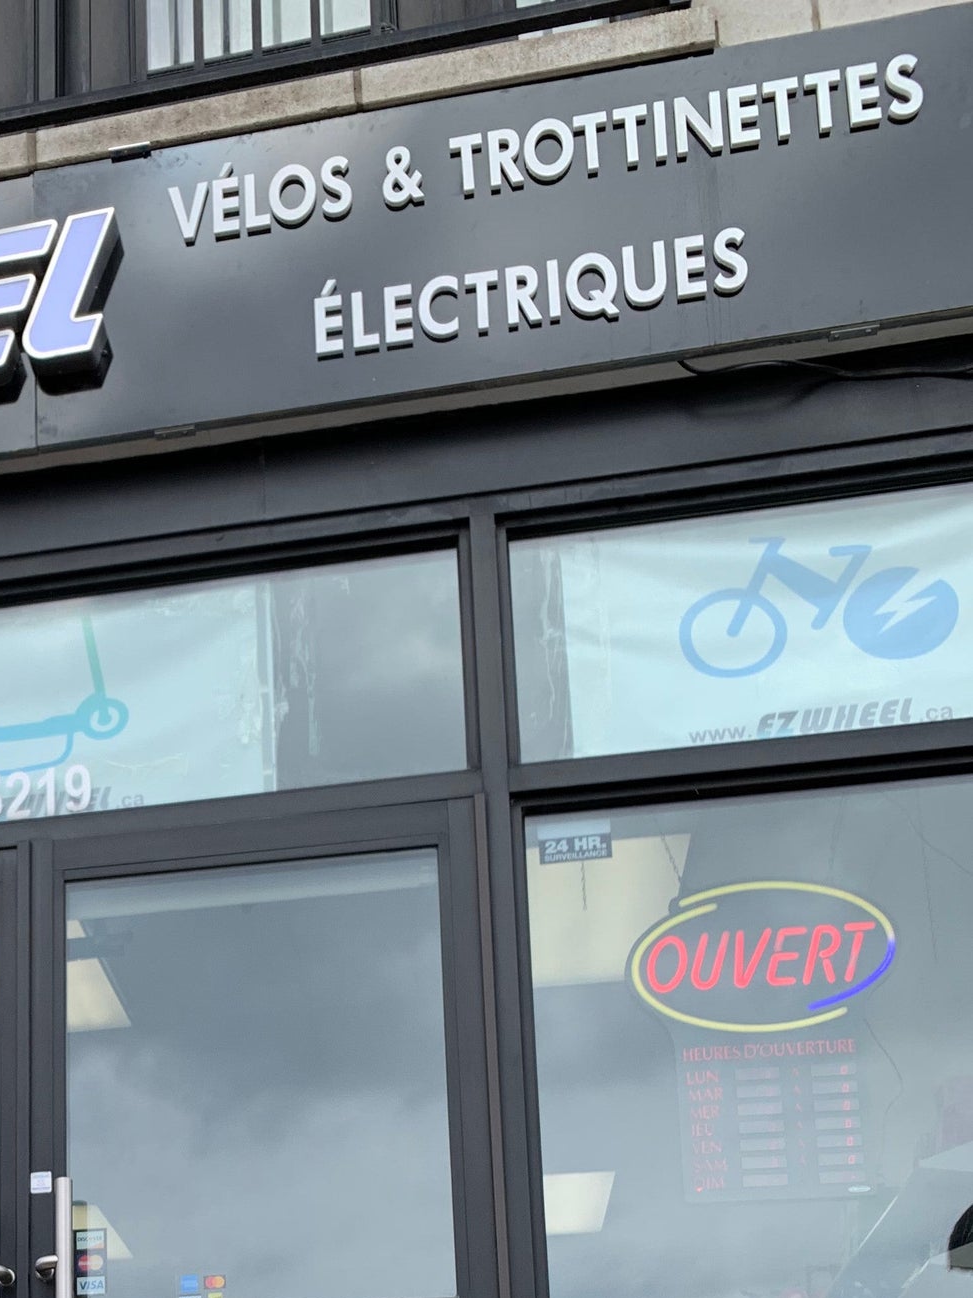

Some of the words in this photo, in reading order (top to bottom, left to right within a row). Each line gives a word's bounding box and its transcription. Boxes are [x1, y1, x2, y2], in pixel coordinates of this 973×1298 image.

[168, 162, 352, 246] VÉLOS
[382, 145, 424, 208] &
[449, 54, 924, 196] TROTTINETTES
[314, 227, 749, 359] ÉLECTRIQUES
[545, 840, 568, 854] 24
[646, 921, 876, 994] OUVERT
[683, 1045, 741, 1062] HEURES
[745, 1038, 856, 1059] D'OUVERTURE
[686, 1070, 720, 1085] LUN
[79, 1280, 104, 1290] VISA
